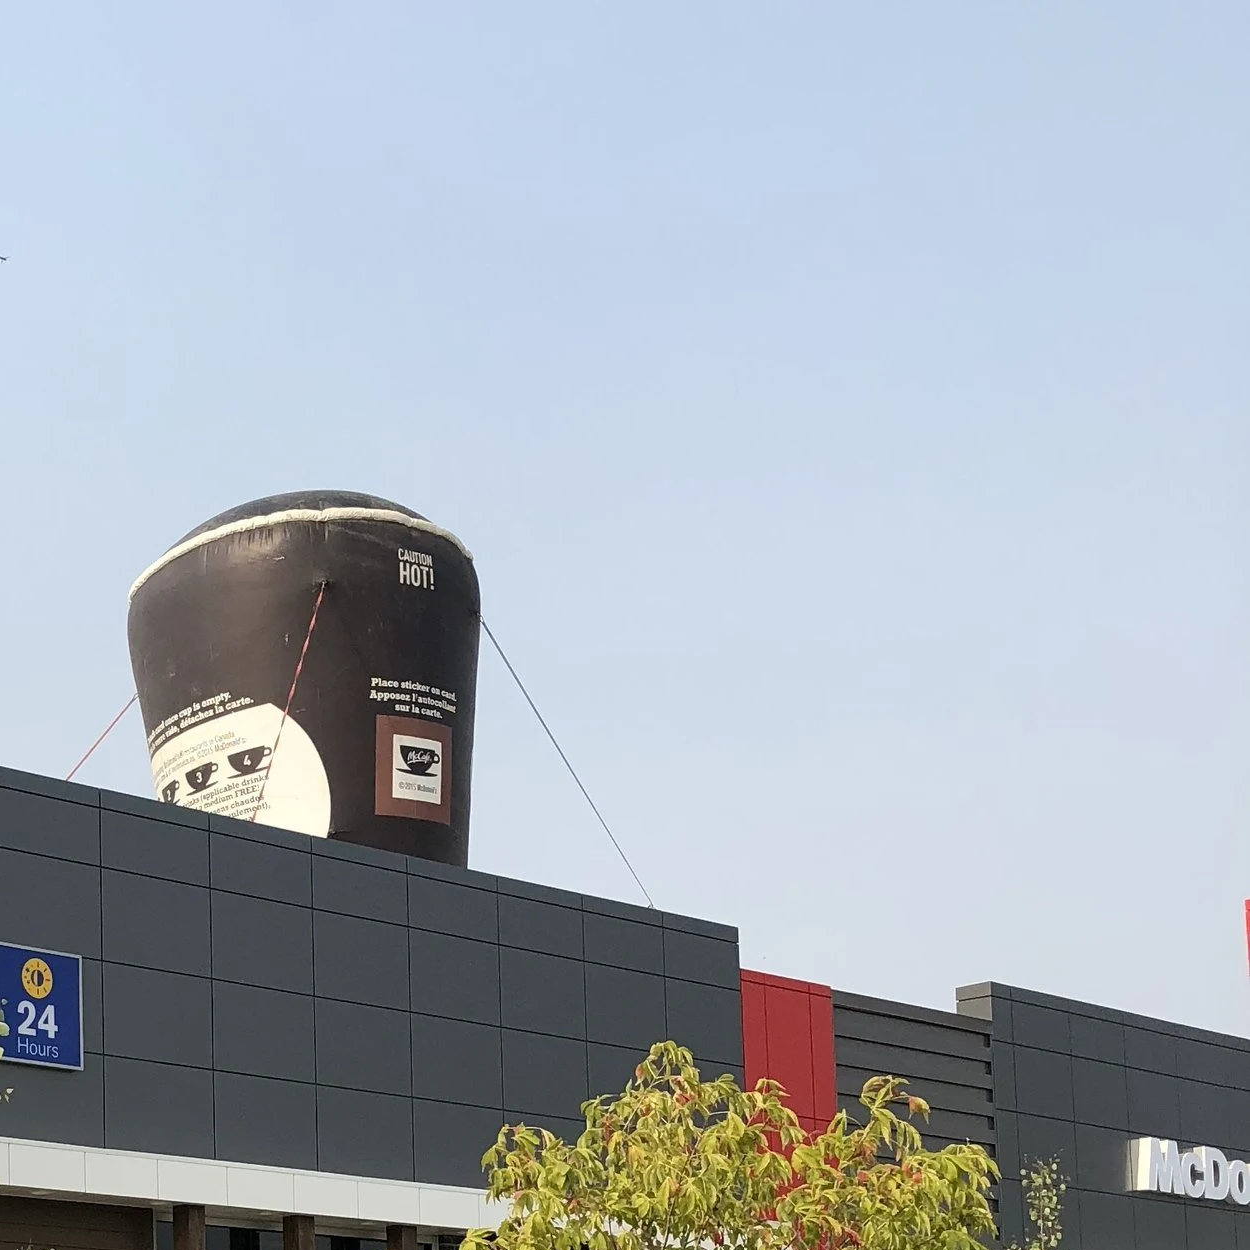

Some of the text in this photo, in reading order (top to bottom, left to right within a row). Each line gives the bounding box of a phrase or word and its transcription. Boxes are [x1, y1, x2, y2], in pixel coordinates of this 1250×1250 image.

[398, 547, 433, 567] CAUTION
[399, 561, 435, 590] HOT!
[369, 689, 456, 713] Apposez l'autocollant
[370, 677, 457, 702] Place sticker on card.
[178, 706, 193, 719] cup
[193, 702, 201, 711] is
[201, 691, 231, 708] empty.
[180, 709, 215, 729] détachez
[215, 704, 225, 714] la
[225, 696, 254, 710] carte.
[394, 704, 443, 719] sur la carte.
[243, 755, 252, 766] 4
[196, 771, 203, 783] 3
[241, 774, 269, 786] drinks
[17, 1000, 59, 1039] 24
[17, 1037, 59, 1058] Hours
[1139, 1136, 1250, 1205] McDo
